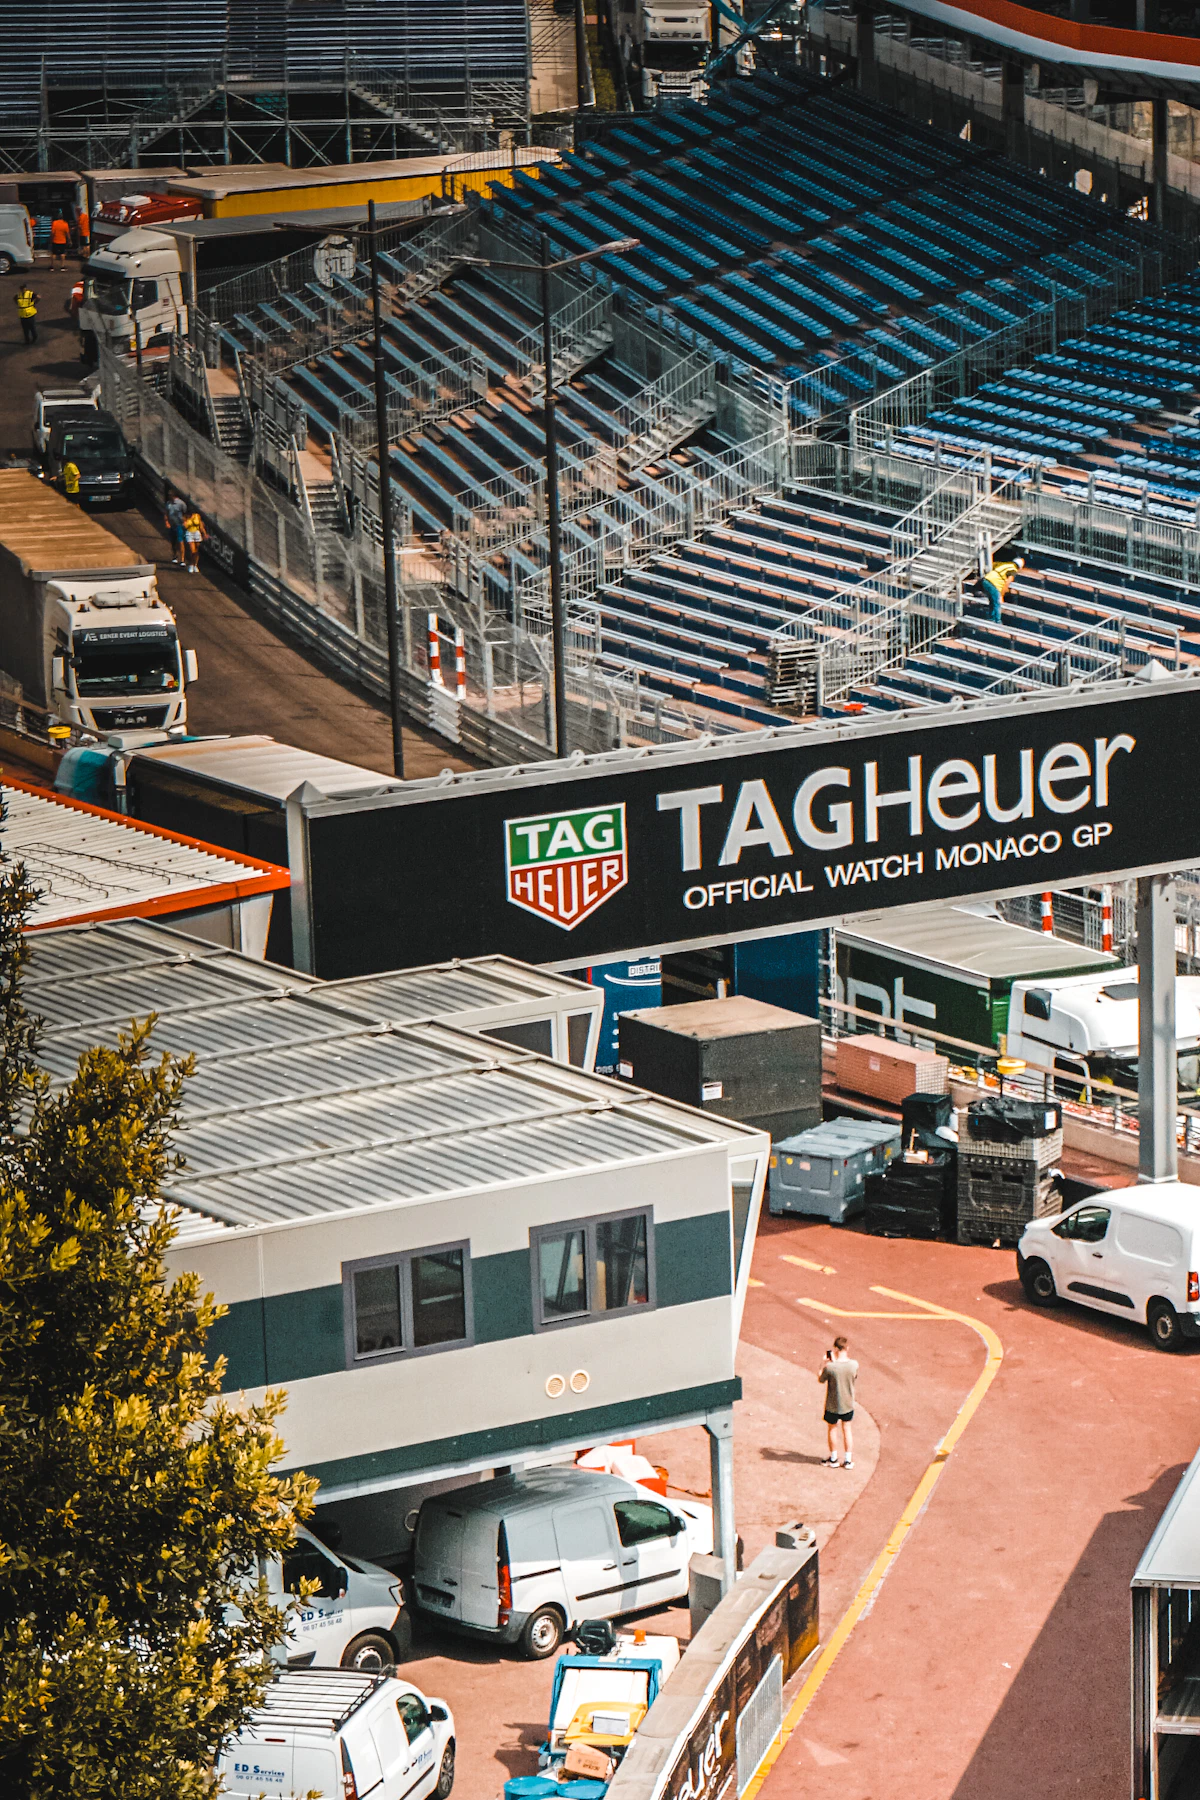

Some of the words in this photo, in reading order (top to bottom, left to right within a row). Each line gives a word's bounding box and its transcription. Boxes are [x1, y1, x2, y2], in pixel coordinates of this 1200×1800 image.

[114, 716, 148, 724] MAN
[515, 810, 616, 860] TAG
[513, 857, 621, 919] HEUER
[683, 870, 813, 911] OFFICIAL
[824, 851, 924, 888] WATCH
[935, 830, 1062, 871] MONACO
[1072, 822, 1114, 849] GP
[234, 1763, 249, 1772] ED
[253, 1765, 285, 1776] Services
